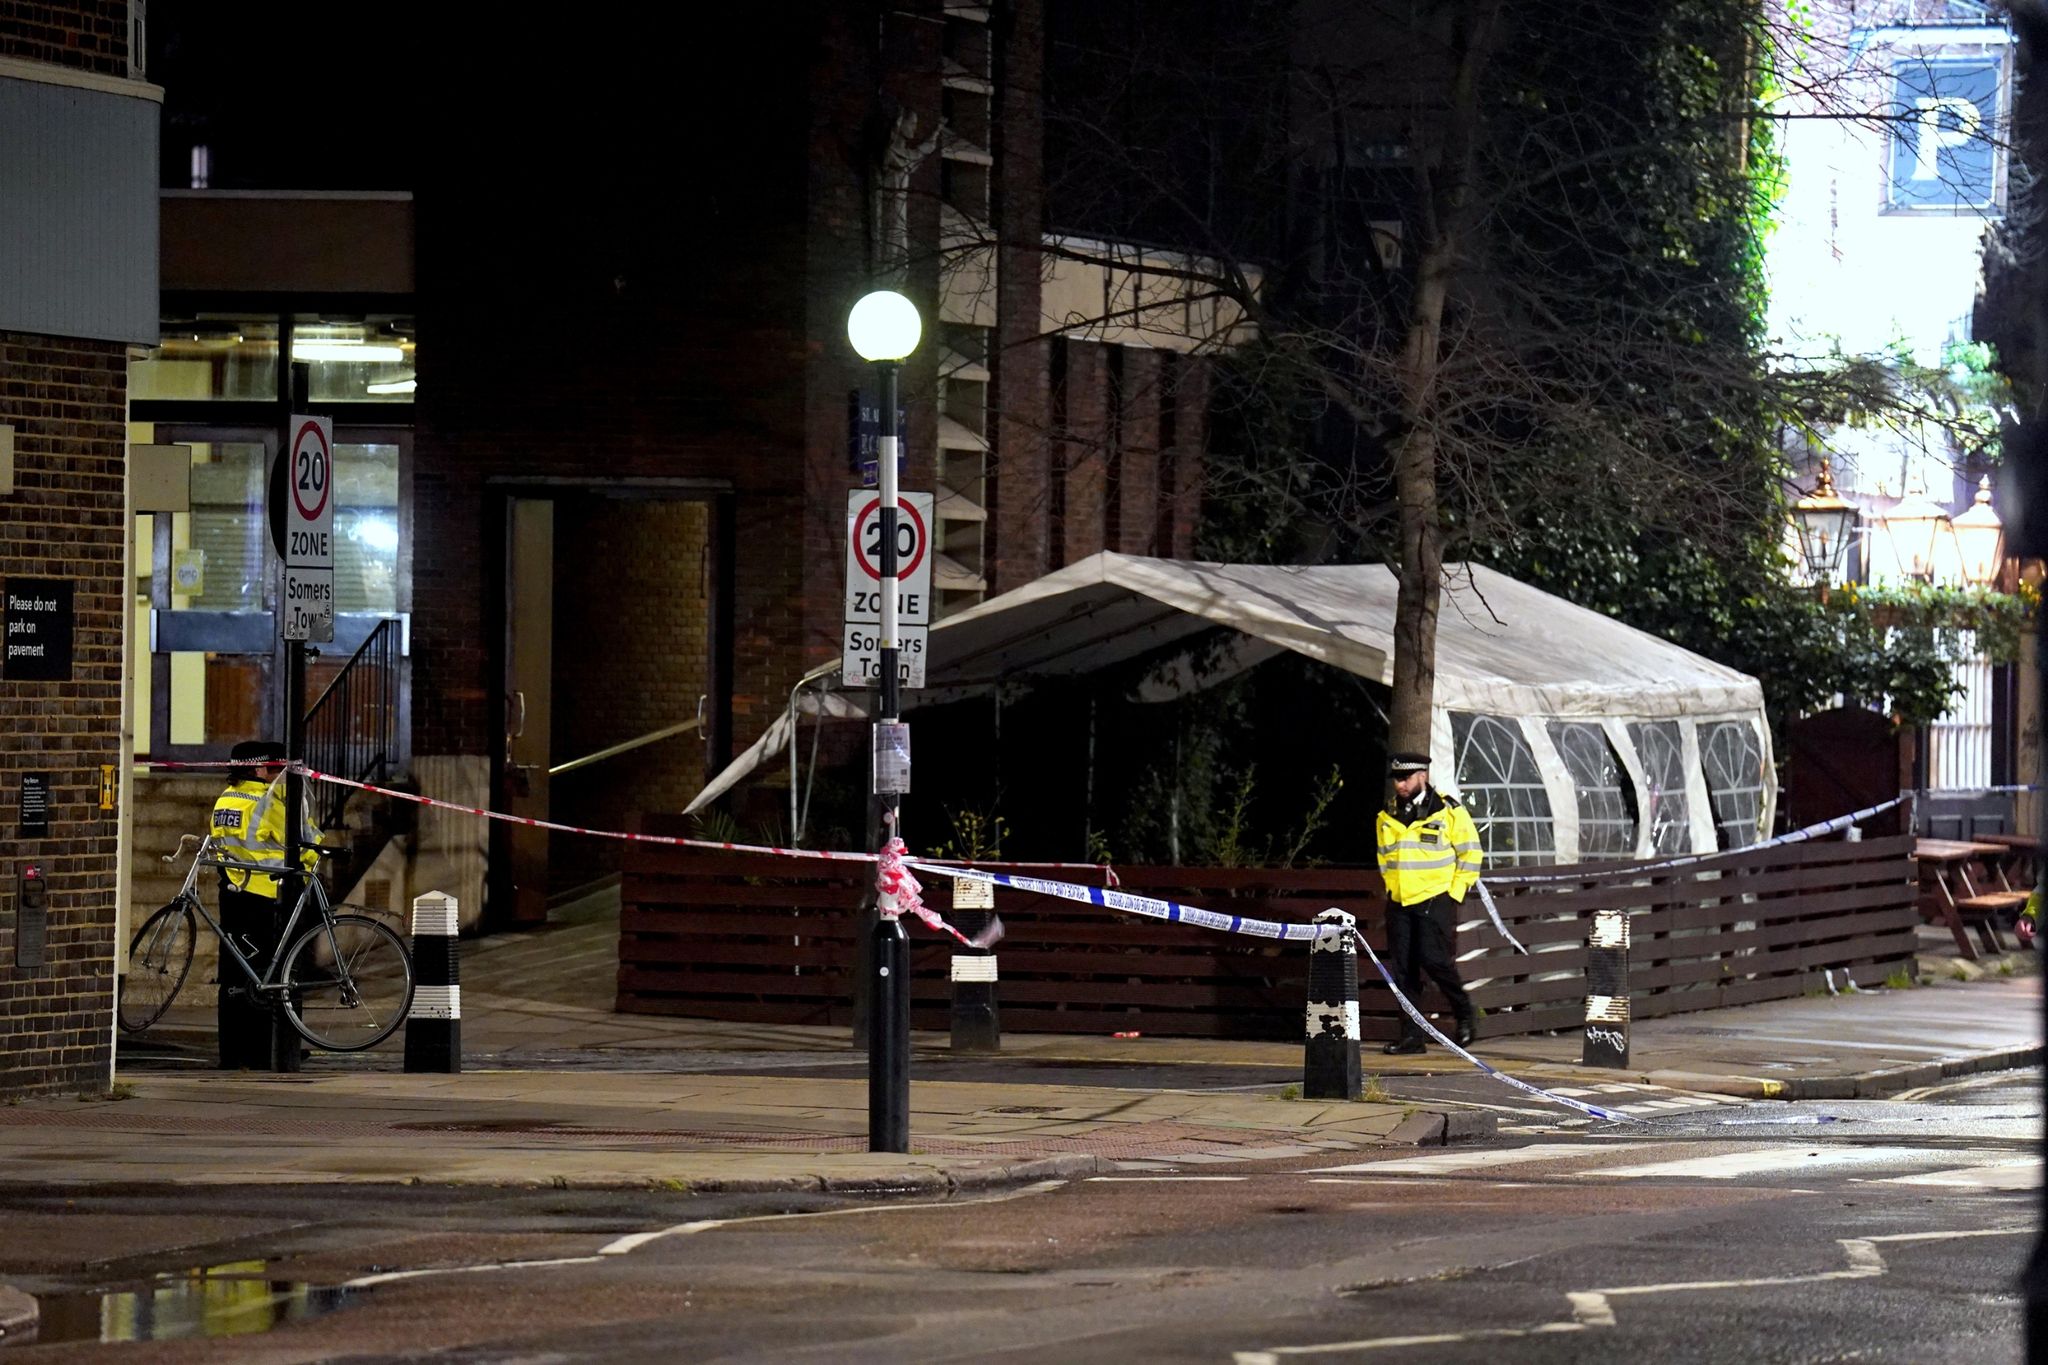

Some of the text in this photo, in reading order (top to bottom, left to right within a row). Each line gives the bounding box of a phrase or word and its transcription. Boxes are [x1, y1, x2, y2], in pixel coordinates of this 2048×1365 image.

[1911, 96, 1981, 181] P
[298, 451, 325, 492] 20
[291, 531, 328, 556] ZONE
[866, 522, 916, 558] 20
[288, 576, 330, 600] Somers
[9, 595, 57, 612] Please do not
[9, 618, 36, 637] park on
[294, 606, 324, 628] Tow
[8, 643, 44, 660] pavement
[849, 631, 922, 653] Sors
[859, 658, 910, 678] Ton
